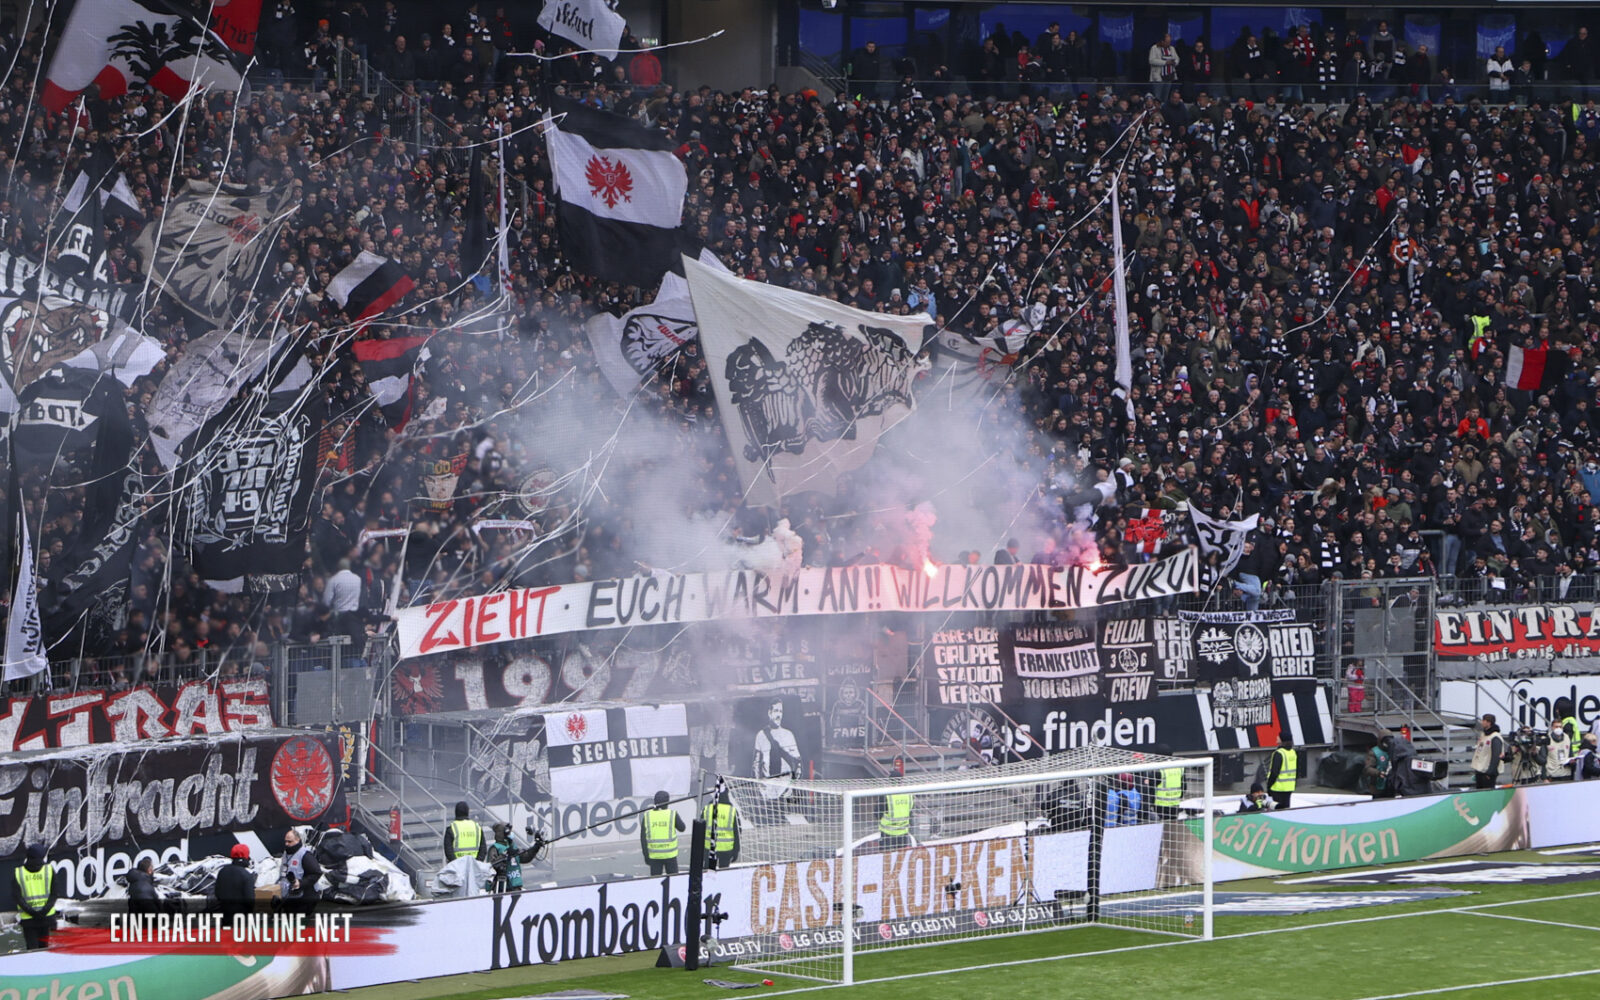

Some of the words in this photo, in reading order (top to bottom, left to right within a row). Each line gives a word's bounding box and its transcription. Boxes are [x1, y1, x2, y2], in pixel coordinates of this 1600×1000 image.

[419, 586, 562, 654] ZIEHT
[586, 575, 686, 628] EUCH
[702, 569, 799, 618] WARM
[889, 564, 1085, 609] WILLKOMMEN
[973, 627, 999, 643] DER
[1104, 618, 1146, 644] FULDA
[1269, 626, 1315, 657] RIED
[934, 644, 1000, 665] GRUPPE
[1018, 648, 1098, 673] FRANKFURT
[1480, 647, 1508, 663] auf
[1517, 644, 1555, 660] ewig
[1564, 643, 1591, 657] dir
[937, 665, 1003, 684] STADION
[1164, 659, 1188, 678] 64
[1271, 657, 1316, 677] GEBIET
[1023, 675, 1099, 699] HOOLIGANS
[1110, 676, 1151, 702] CREW
[1237, 677, 1272, 701] REGION
[1043, 708, 1157, 751] finden
[572, 737, 668, 765] SECHSDREI
[750, 837, 1034, 936] CASH-KORKEN
[491, 877, 722, 969] Krombachr
[892, 923, 908, 938] LG
[911, 918, 940, 934] OLED
[940, 916, 957, 930] TV
[988, 910, 1006, 925] LG
[794, 933, 810, 947] LG
[814, 929, 844, 944] OLED
